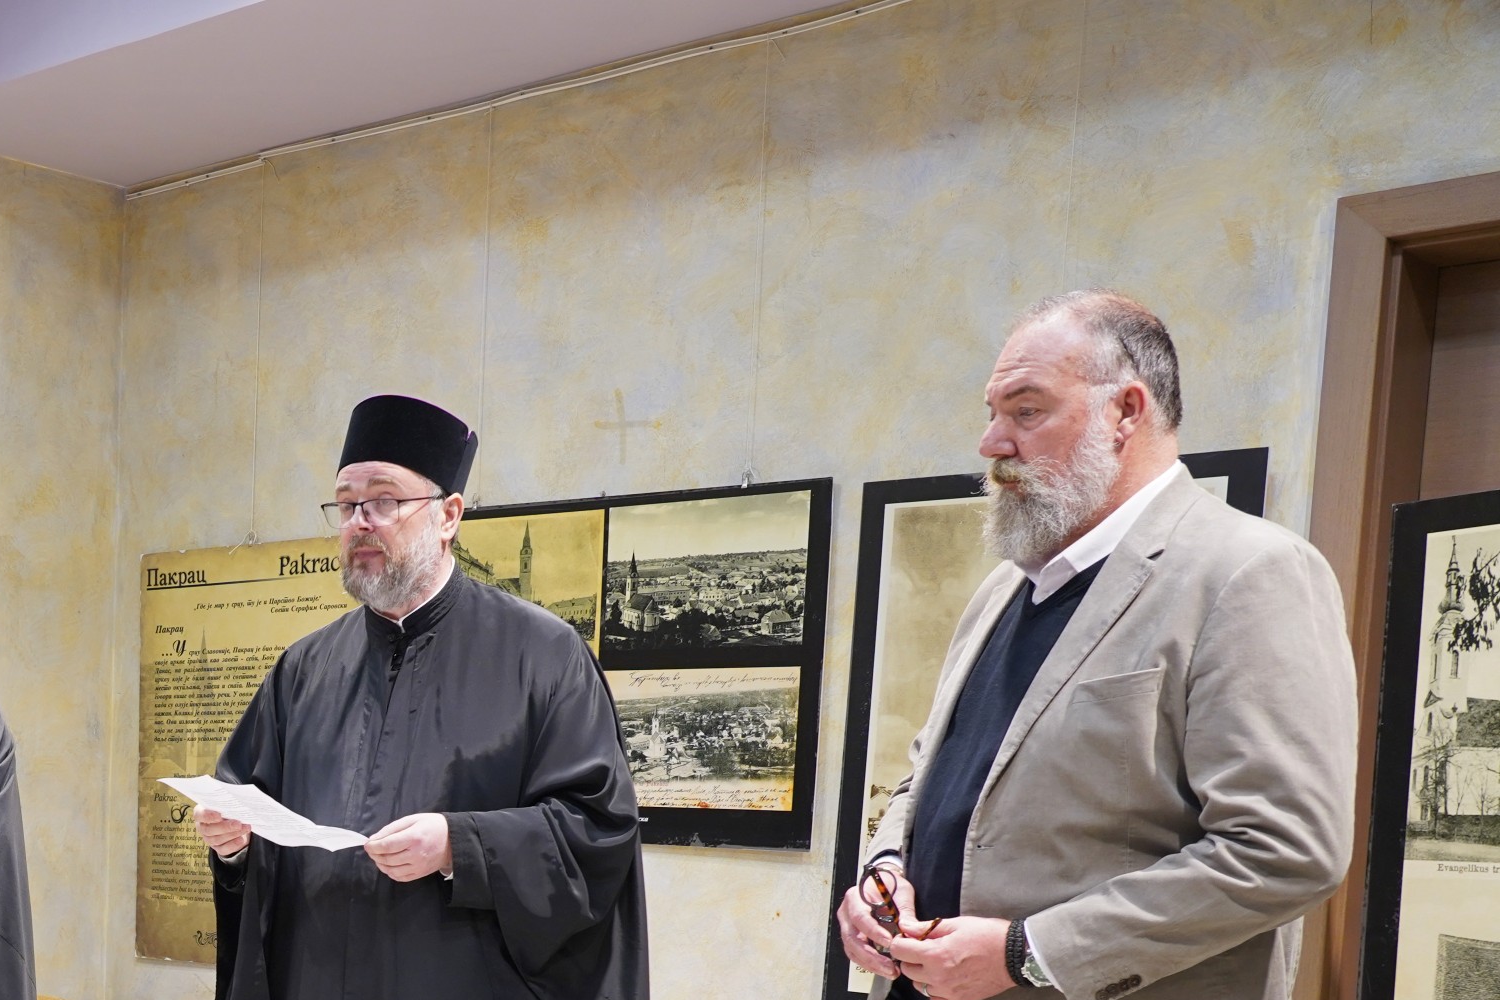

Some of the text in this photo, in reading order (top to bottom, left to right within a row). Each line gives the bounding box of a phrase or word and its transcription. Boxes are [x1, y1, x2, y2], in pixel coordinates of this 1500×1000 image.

[279, 553, 340, 576] Pakrac
[146, 568, 206, 587] Пакрац
[206, 602, 213, 610] је
[256, 599, 262, 607] је
[291, 604, 318, 614] Серафим
[320, 602, 348, 612] Саровски
[155, 625, 184, 635] Пакрац
[154, 793, 177, 802] Pakrac
[1437, 864, 1489, 874] Evangelikus
